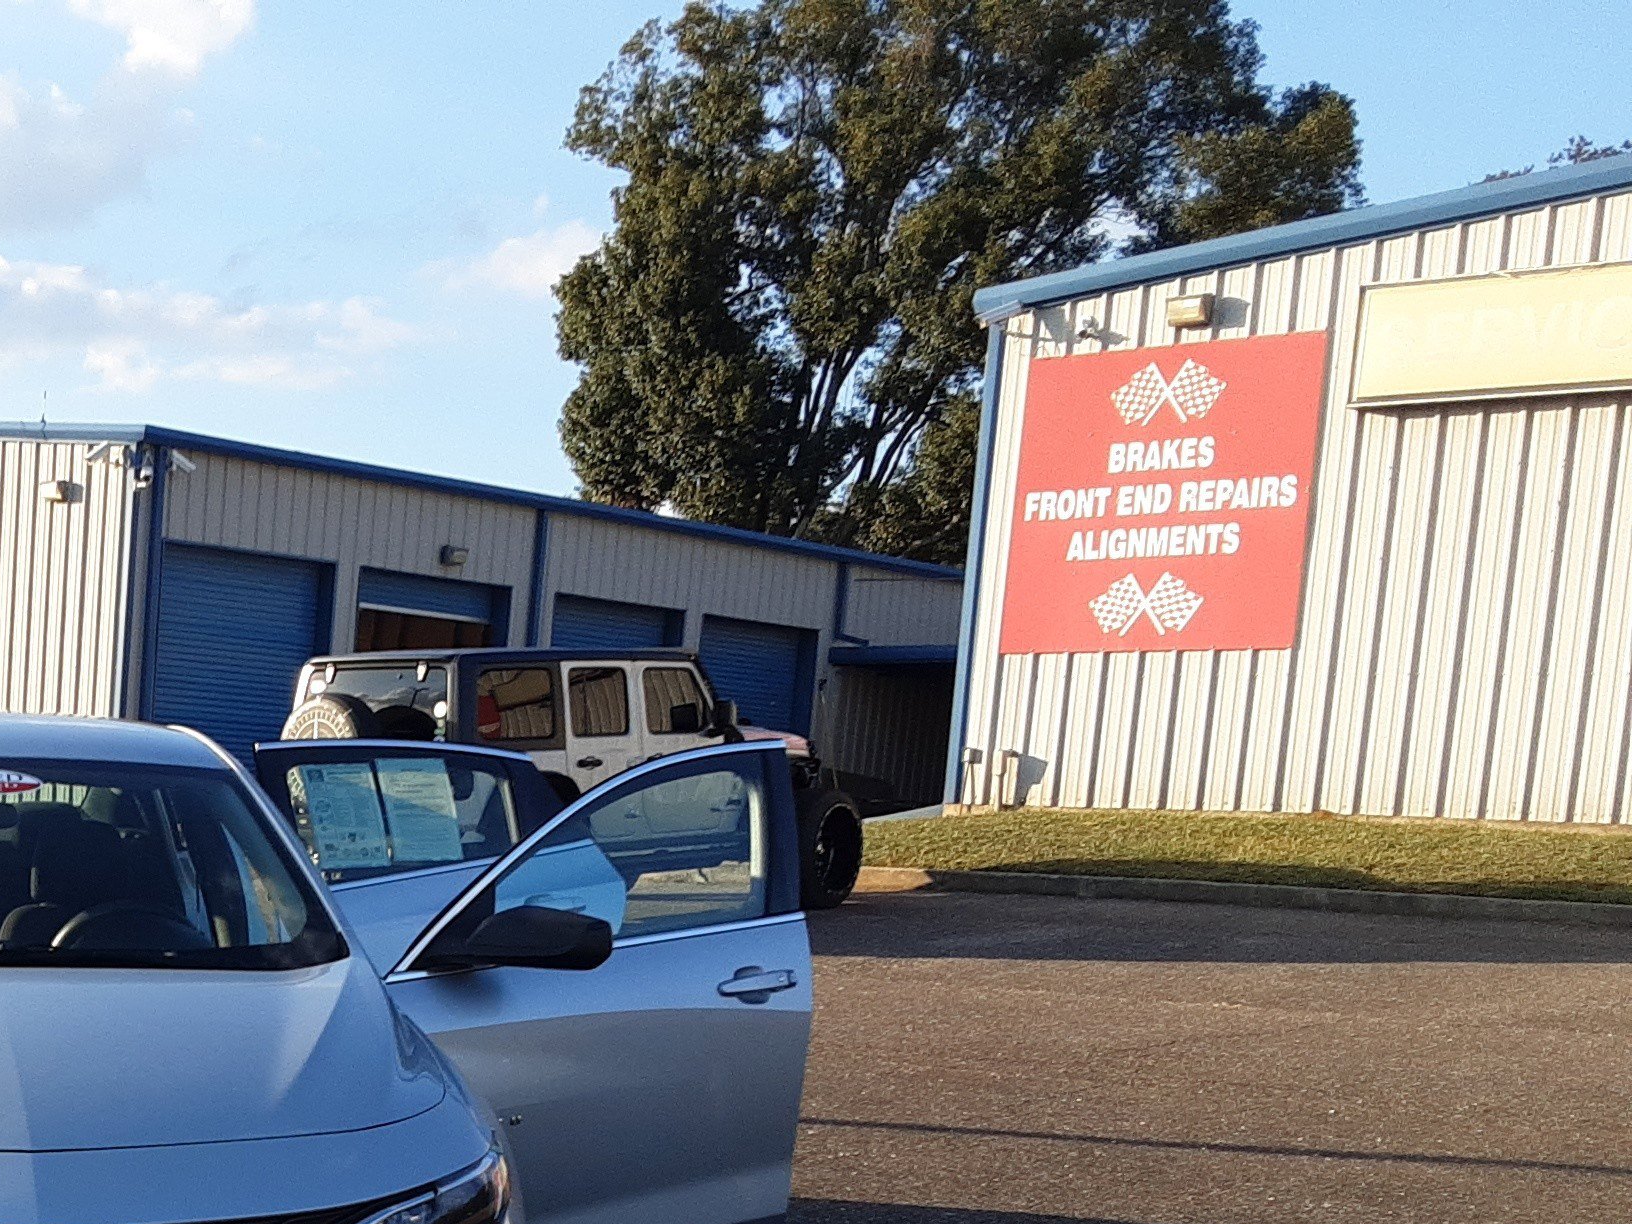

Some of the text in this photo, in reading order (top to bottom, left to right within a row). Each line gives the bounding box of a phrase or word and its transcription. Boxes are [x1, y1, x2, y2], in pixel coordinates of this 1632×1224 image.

[1107, 435, 1215, 474] BRAKES
[1023, 474, 1298, 522] FRONT END REPAIRS
[1065, 522, 1240, 562] ALIGNMENTS
